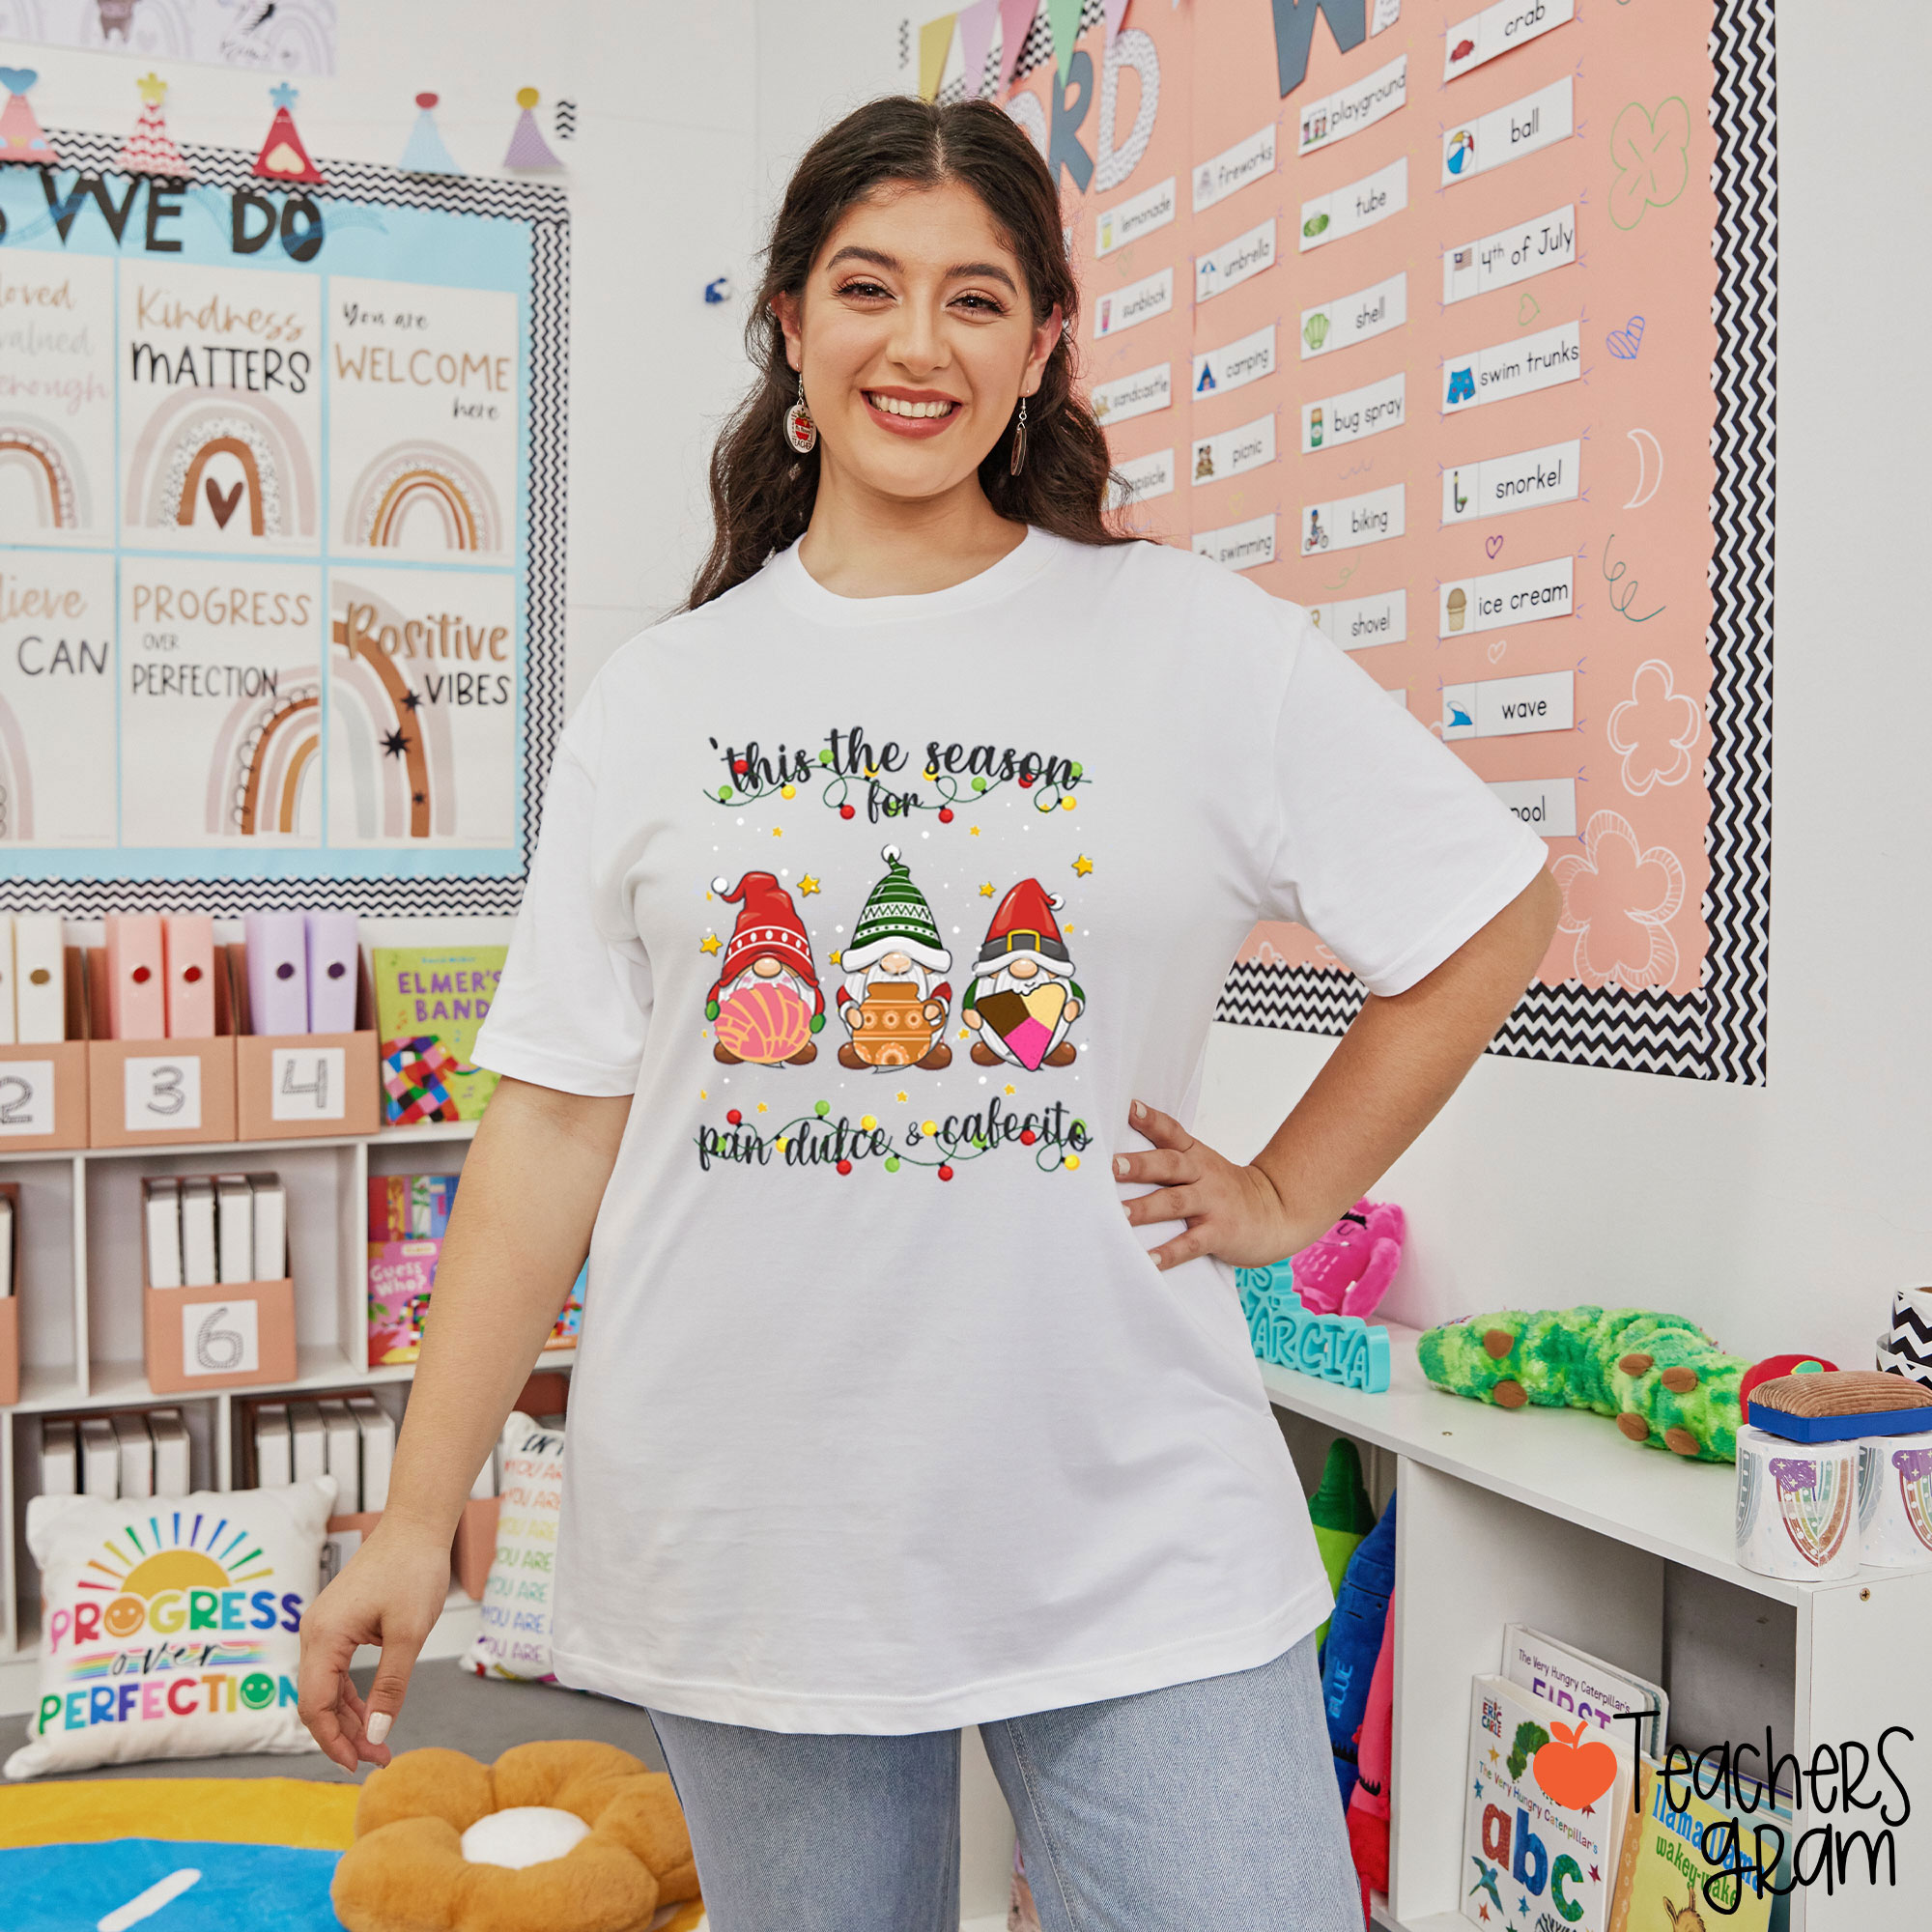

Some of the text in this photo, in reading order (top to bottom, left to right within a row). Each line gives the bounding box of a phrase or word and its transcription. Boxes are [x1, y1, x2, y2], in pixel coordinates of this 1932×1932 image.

[1504, 0, 1546, 37] crab
[1331, 64, 1406, 131] playground
[1511, 107, 1539, 145] ball
[1218, 144, 1273, 189] fireworks
[40, 168, 185, 252] WE
[231, 188, 324, 263] DO
[1122, 193, 1171, 233] lemonade
[1356, 188, 1386, 217] tube
[1224, 238, 1270, 278] umbrella
[1481, 223, 1574, 273] 4th of July
[136, 286, 306, 342] Kindness
[343, 301, 429, 330] You are
[1122, 283, 1166, 319] sunblock
[1355, 296, 1385, 329] shell
[335, 343, 511, 392] WELCOME
[1225, 348, 1269, 378] camping
[1480, 340, 1579, 386] swim trunks
[452, 396, 500, 422] here
[1113, 374, 1169, 409] sandcastle
[1334, 397, 1404, 434] bug spray
[1233, 440, 1263, 469] picnic
[1496, 459, 1562, 498] snorkel
[1351, 508, 1388, 533] biking
[1219, 535, 1272, 563] swimming
[0, 570, 89, 624] lieve
[132, 584, 312, 626] PROGRESS
[1478, 582, 1569, 616] ice cream
[345, 601, 509, 661] Positive
[1351, 607, 1391, 637] shovel
[17, 636, 109, 676] CAN
[142, 632, 181, 652] OVER
[131, 664, 279, 698] PERFECTION
[426, 671, 511, 706] VIBES
[1502, 697, 1548, 720] wave
[825, 725, 908, 774] the
[926, 738, 1081, 790] season
[868, 780, 923, 823] for
[398, 971, 501, 994] ELMER'S
[415, 999, 490, 1023] BAND
[146, 1065, 185, 1115] 3
[280, 1059, 327, 1108] 4
[699, 1123, 772, 1172] pan
[784, 1117, 892, 1167] dulce
[943, 1096, 1088, 1152] cafecito
[369, 1262, 423, 1283] Guess
[375, 1273, 428, 1296] Who?
[194, 1307, 243, 1369] 6
[1249, 1306, 1370, 1391] ARCIA
[542, 1462, 564, 1481] AR
[526, 1520, 558, 1542] ARE
[521, 1552, 554, 1574] ARE
[515, 1581, 548, 1605] ARE
[51, 1590, 302, 1653] PROGRESS
[512, 1609, 546, 1635] ARE
[111, 1641, 227, 1677] over
[511, 1642, 543, 1663] ARE
[1329, 1661, 1354, 1719] BLUE
[1519, 1648, 1632, 1715] The Very Hungry Caterpillar's
[38, 1672, 298, 1735] PERFECTION
[1482, 1701, 1502, 1725] ERIC
[1481, 1715, 1502, 1739] CARLE
[1479, 1760, 1598, 1855] The Very Hungry Caterpillar's
[1482, 1803, 1584, 1922] abc
